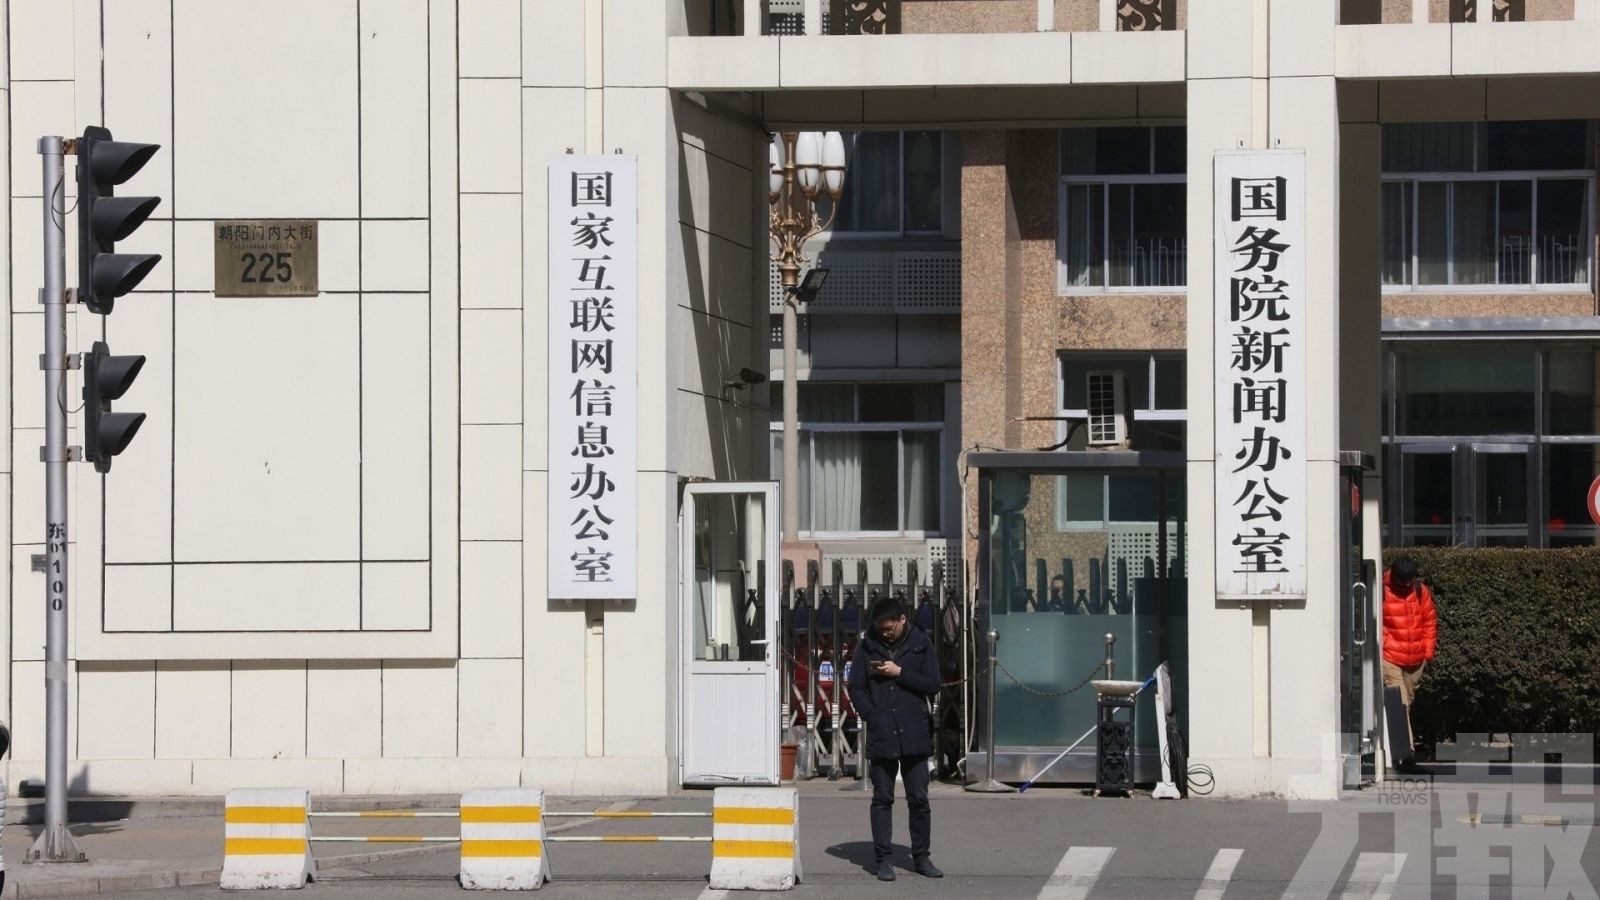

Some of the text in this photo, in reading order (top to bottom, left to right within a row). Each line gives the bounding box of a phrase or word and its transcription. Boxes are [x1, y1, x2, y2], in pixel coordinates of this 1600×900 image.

[219, 225, 313, 240] 朝阳门内大街
[241, 252, 292, 283] 225
[569, 170, 616, 583] 国家互联网信息办公室
[1229, 175, 1292, 574] 国务院新闻办公室
